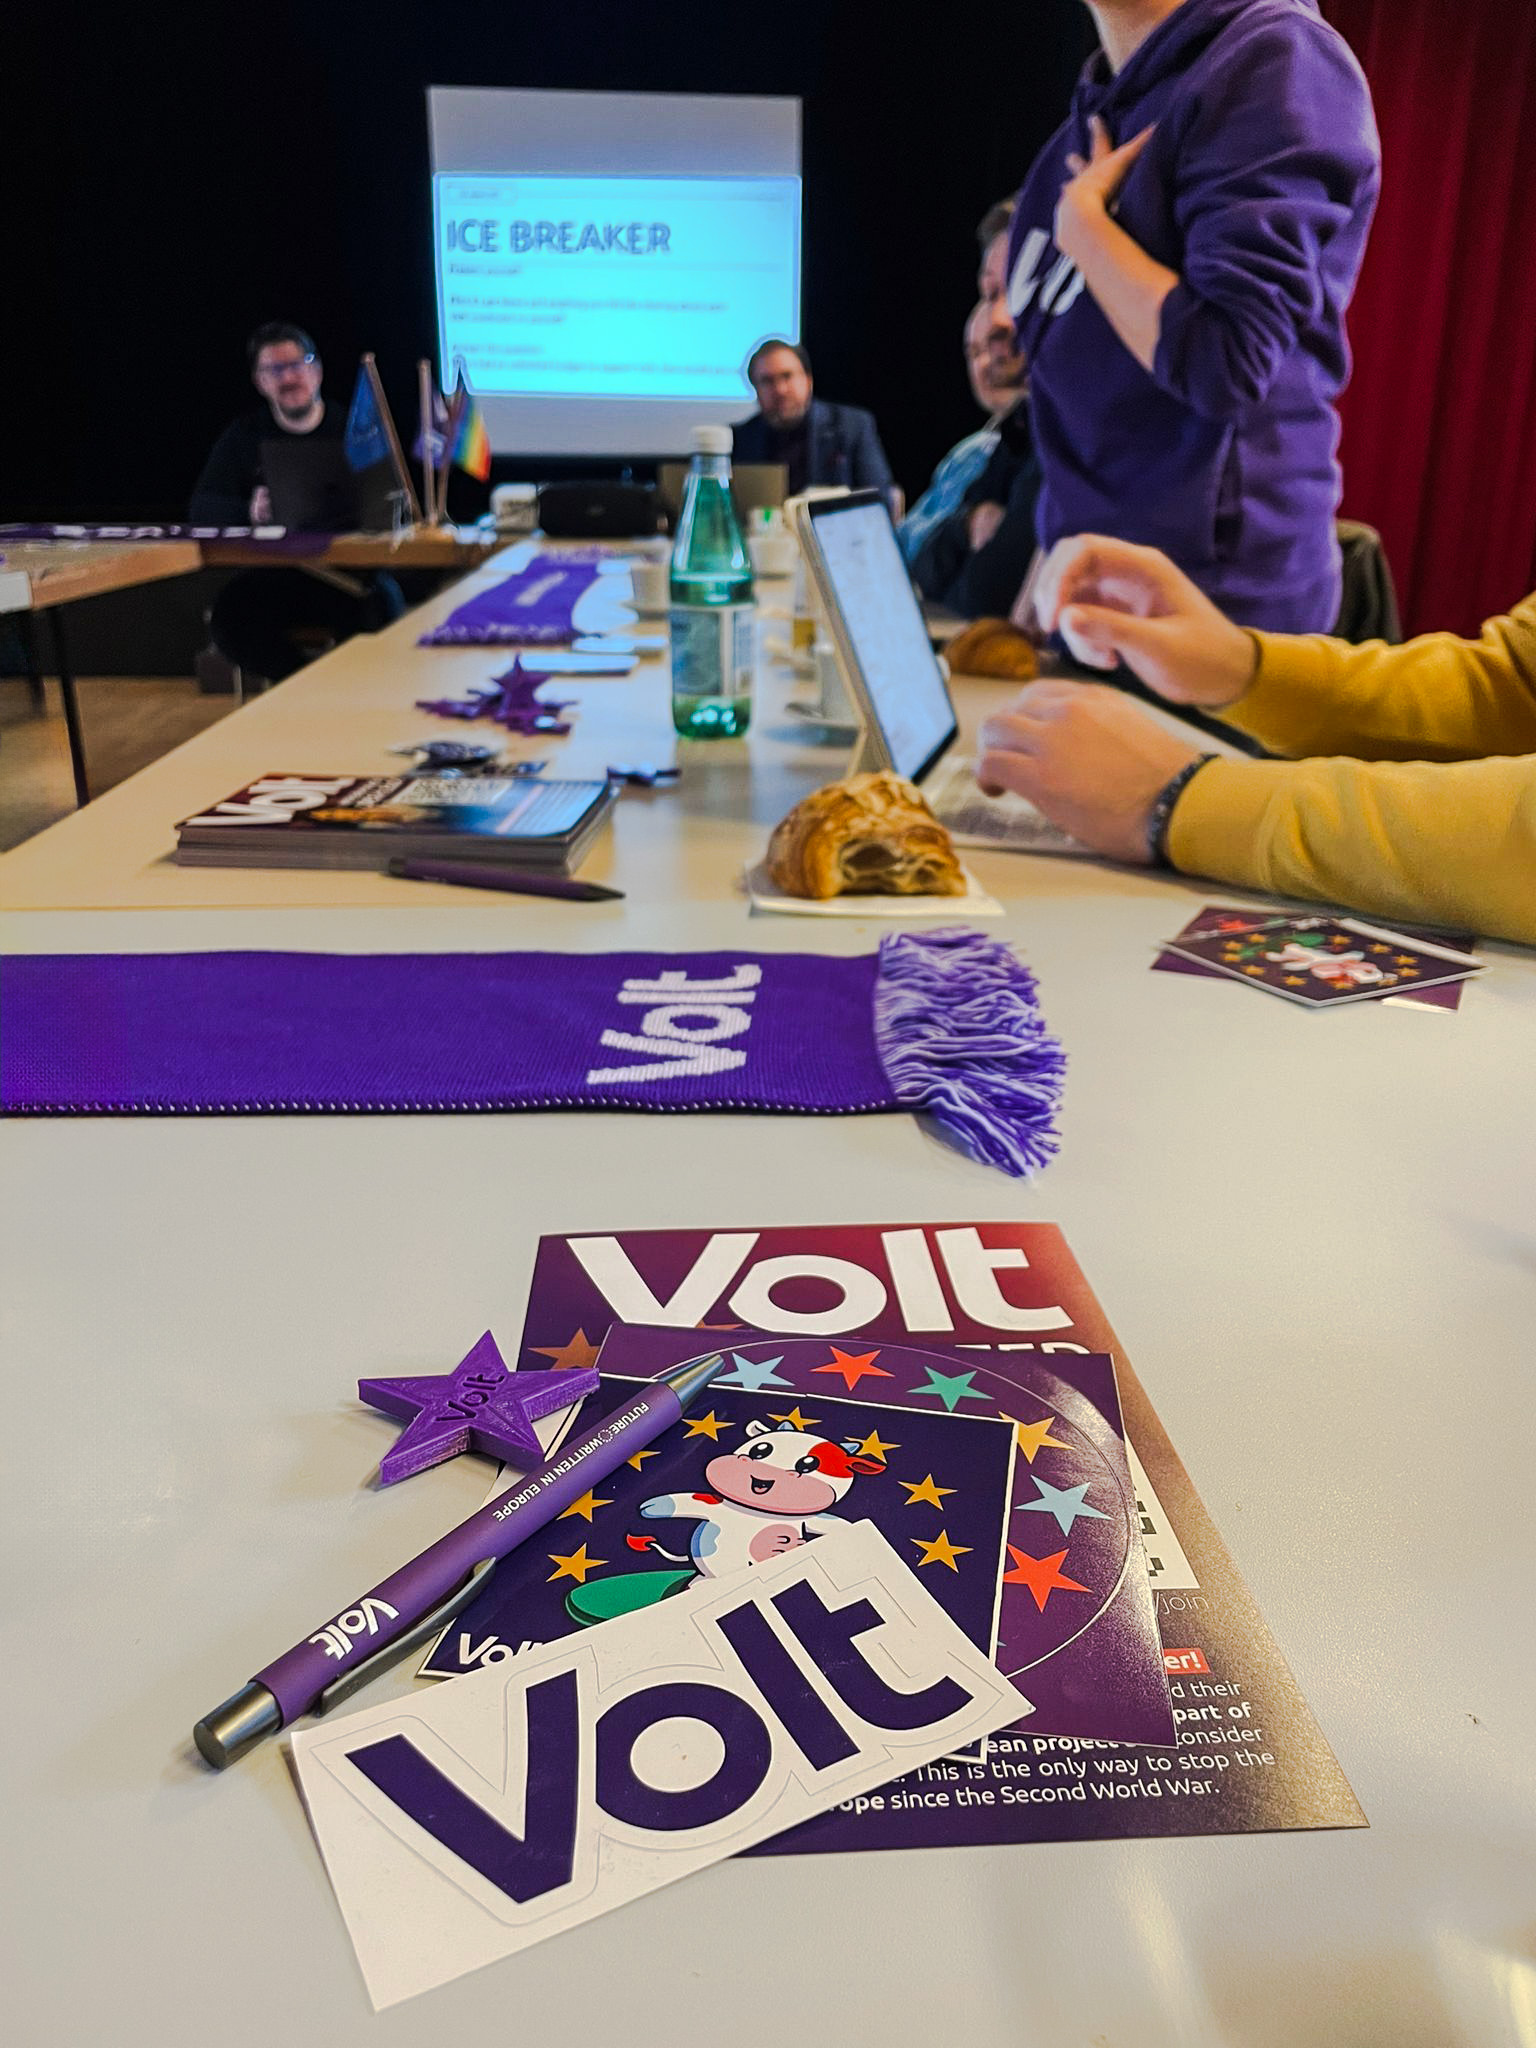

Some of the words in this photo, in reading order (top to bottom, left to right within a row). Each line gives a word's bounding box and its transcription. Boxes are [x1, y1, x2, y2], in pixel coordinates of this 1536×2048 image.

[446, 219, 498, 253] ICE
[510, 220, 672, 255] BREAKER
[187, 777, 356, 827] Volt
[587, 964, 762, 1085] Volt
[566, 1227, 1075, 1335] Volt
[435, 1374, 505, 1421] Volt
[608, 1402, 650, 1434] FUTURE
[553, 1438, 603, 1476] WRITTEN
[540, 1473, 557, 1486] IN
[492, 1484, 541, 1522] EUROPE
[1156, 1592, 1209, 1614] /join
[308, 1597, 400, 1661] Volt
[1164, 1651, 1202, 1669] er!
[1190, 1681, 1241, 1697] their
[1173, 1705, 1222, 1724] part
[1228, 1702, 1252, 1718] of
[345, 1579, 974, 1904] Volt
[988, 1738, 1027, 1754] ean
[968, 1763, 985, 1780] is
[992, 1760, 1031, 1778] the
[1039, 1757, 1086, 1779] only
[1094, 1758, 1139, 1776] way
[1146, 1755, 1172, 1772] to
[1178, 1753, 1229, 1772] stop
[1235, 1749, 1276, 1767] the
[830, 1796, 885, 1815] ope
[890, 1790, 950, 1809] since
[955, 1787, 995, 1806] the
[1000, 1781, 1087, 1804] Second
[1090, 1778, 1163, 1800] World
[1165, 1777, 1221, 1797] War.
